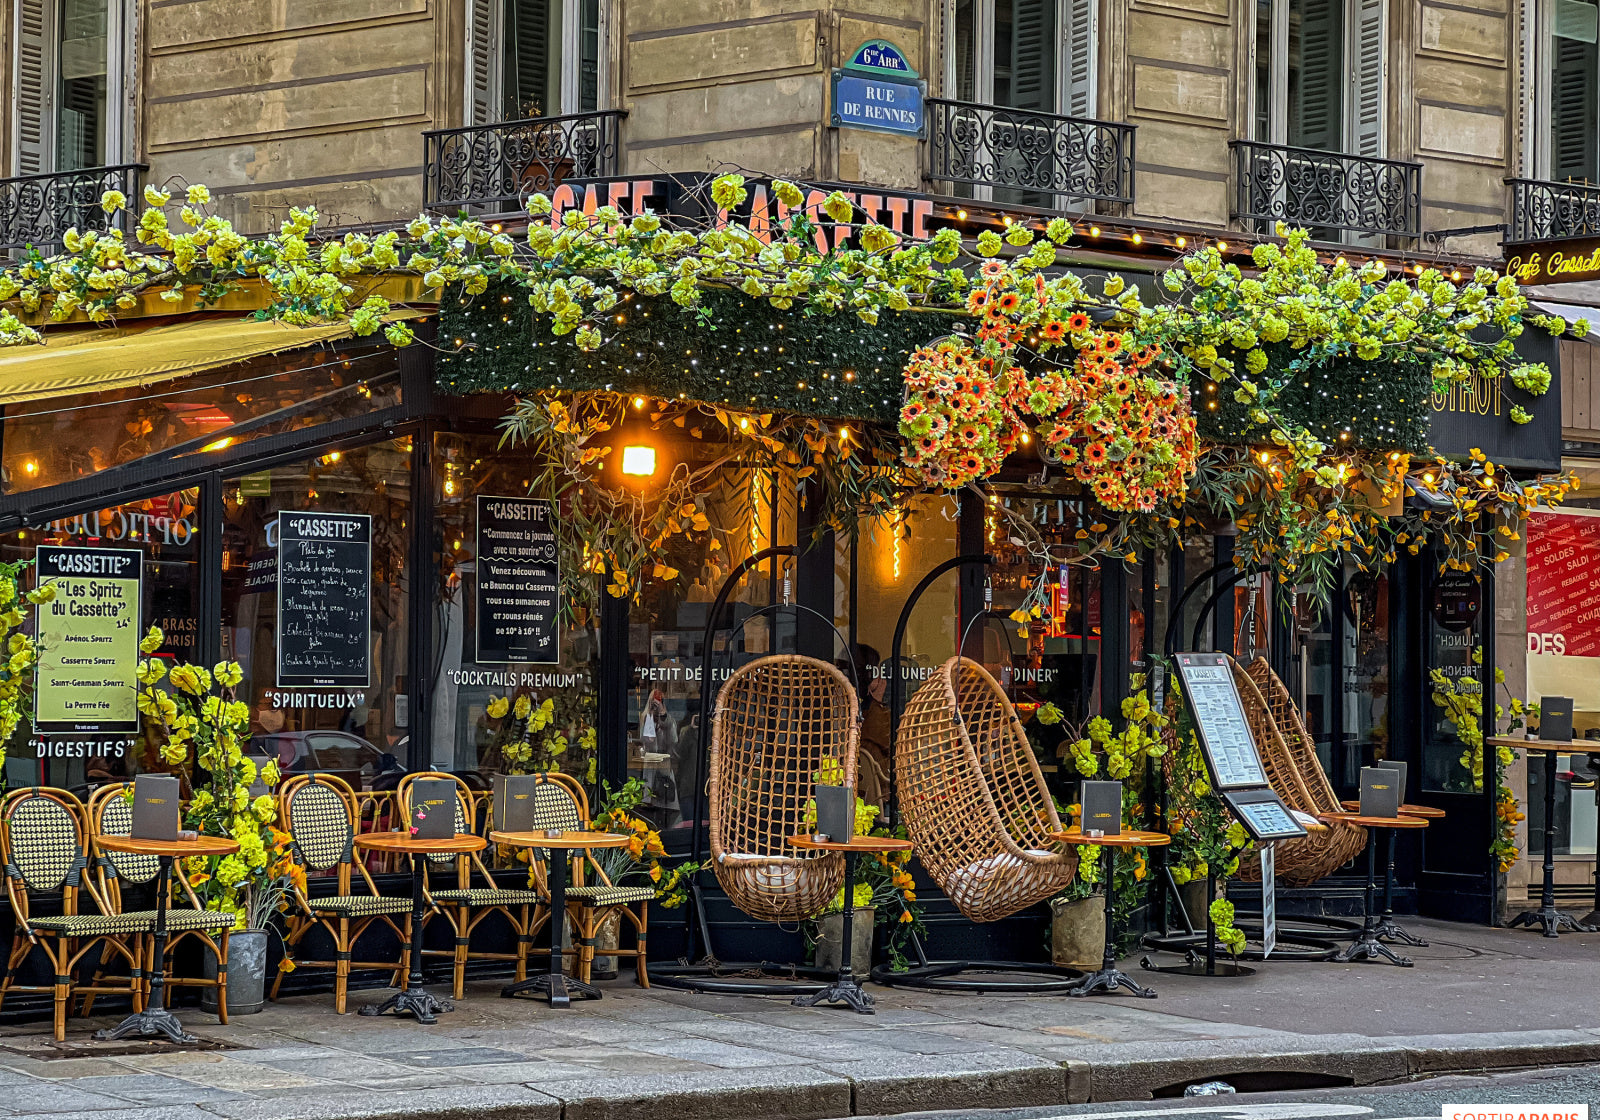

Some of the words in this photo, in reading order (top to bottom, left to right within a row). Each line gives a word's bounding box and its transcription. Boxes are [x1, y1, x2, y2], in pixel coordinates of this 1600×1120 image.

[866, 86, 895, 103] RUE
[844, 101, 861, 117] DE
[865, 104, 916, 124] RENNES
[1506, 252, 1541, 280] Café
[486, 502, 551, 521] “CASSETTE”
[289, 518, 362, 539] “CASSETTE”
[524, 529, 531, 540] la
[1580, 524, 1596, 537] SALE
[493, 546, 508, 554] avec
[508, 546, 517, 555] un
[1535, 542, 1552, 555] SALE
[1543, 546, 1575, 566] SOLDES
[48, 553, 131, 574] “CASSETTE”
[1566, 554, 1590, 571] SALDI
[57, 580, 86, 598] “Les
[89, 580, 123, 601] Spritz
[51, 599, 66, 616] du
[69, 600, 127, 617] Cassette”
[447, 668, 517, 687] “COCKTAILS
[520, 672, 583, 688] PREMIUM”
[634, 666, 681, 681] “PETIT
[1005, 667, 1059, 683] “DINER”
[264, 690, 366, 708] “SPIRITUEUX”
[28, 739, 135, 758] “DIGESTIFS”
